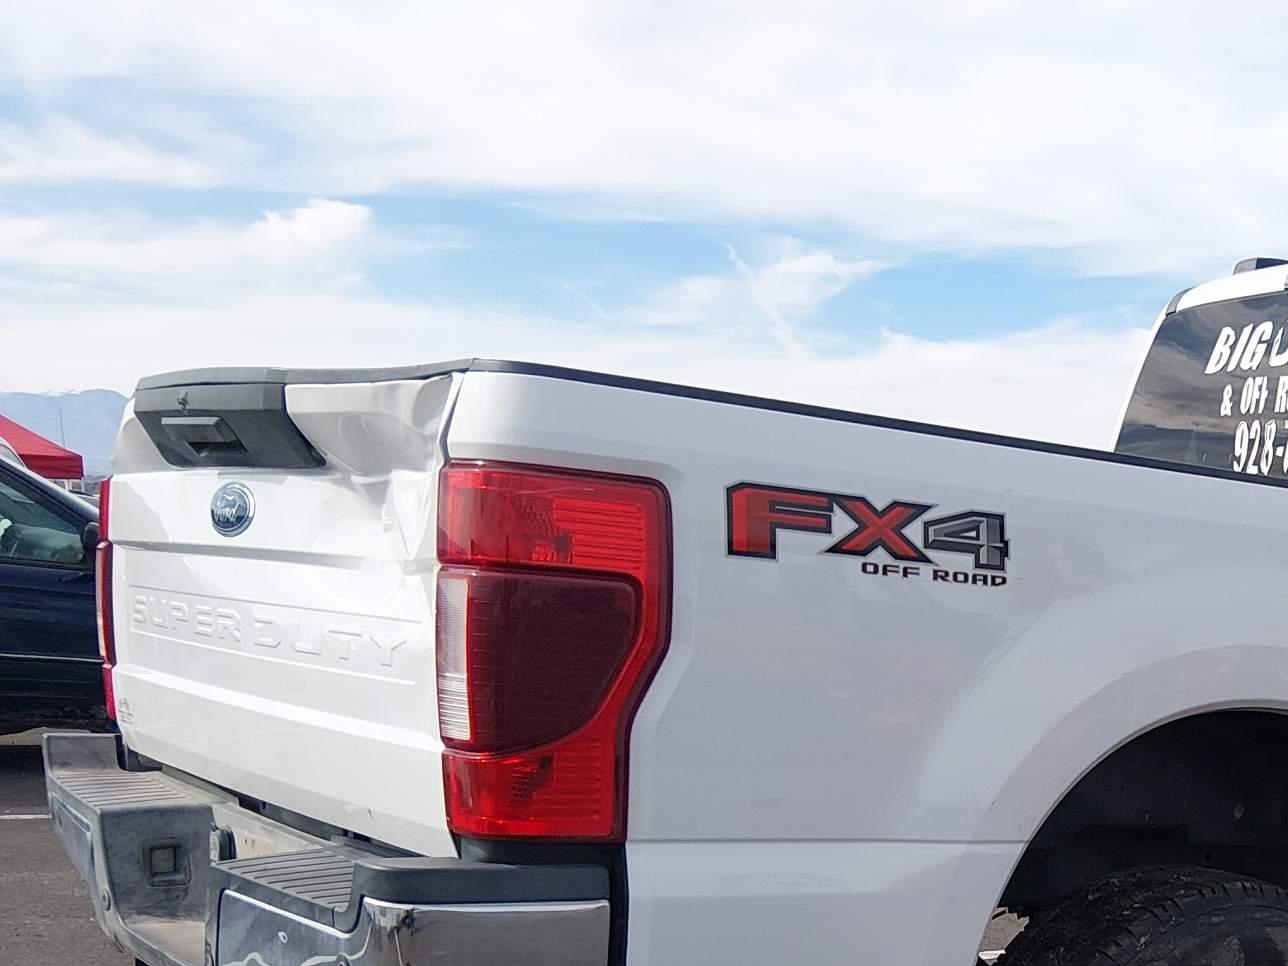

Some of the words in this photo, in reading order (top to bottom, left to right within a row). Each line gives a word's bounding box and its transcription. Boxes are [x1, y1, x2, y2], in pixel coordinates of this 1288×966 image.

[1204, 321, 1274, 374] BIG
[1220, 384, 1233, 416] &
[725, 480, 1010, 572] FX4
[861, 562, 921, 579] OFF
[932, 568, 1008, 588] ROAD
[130, 595, 242, 643] SUPER
[252, 613, 408, 668] DUTY
